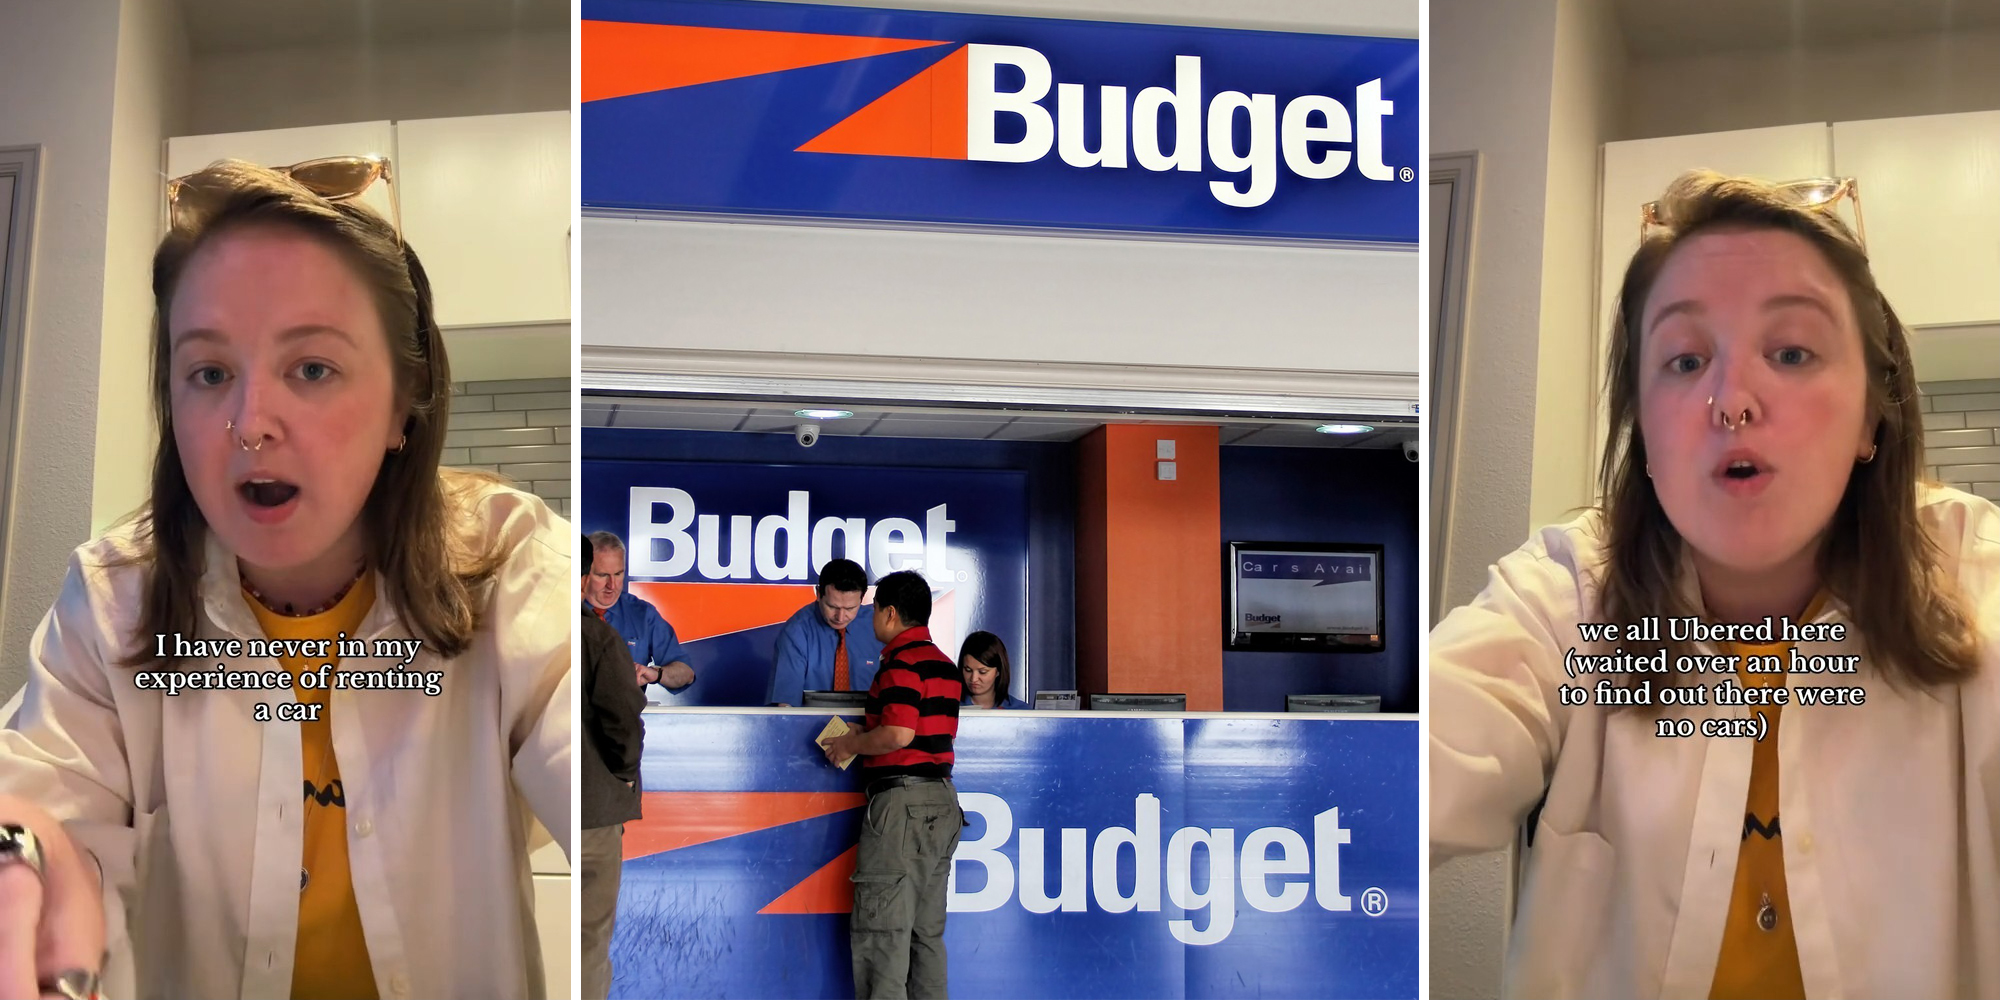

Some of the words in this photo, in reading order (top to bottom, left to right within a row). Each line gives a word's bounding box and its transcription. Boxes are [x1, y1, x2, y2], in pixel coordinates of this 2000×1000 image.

[967, 43, 1394, 207] Budget
[628, 486, 956, 583] Budget
[1242, 561, 1299, 573] Cars
[1245, 613, 1281, 624] Budget
[947, 792, 1352, 945] Budget
